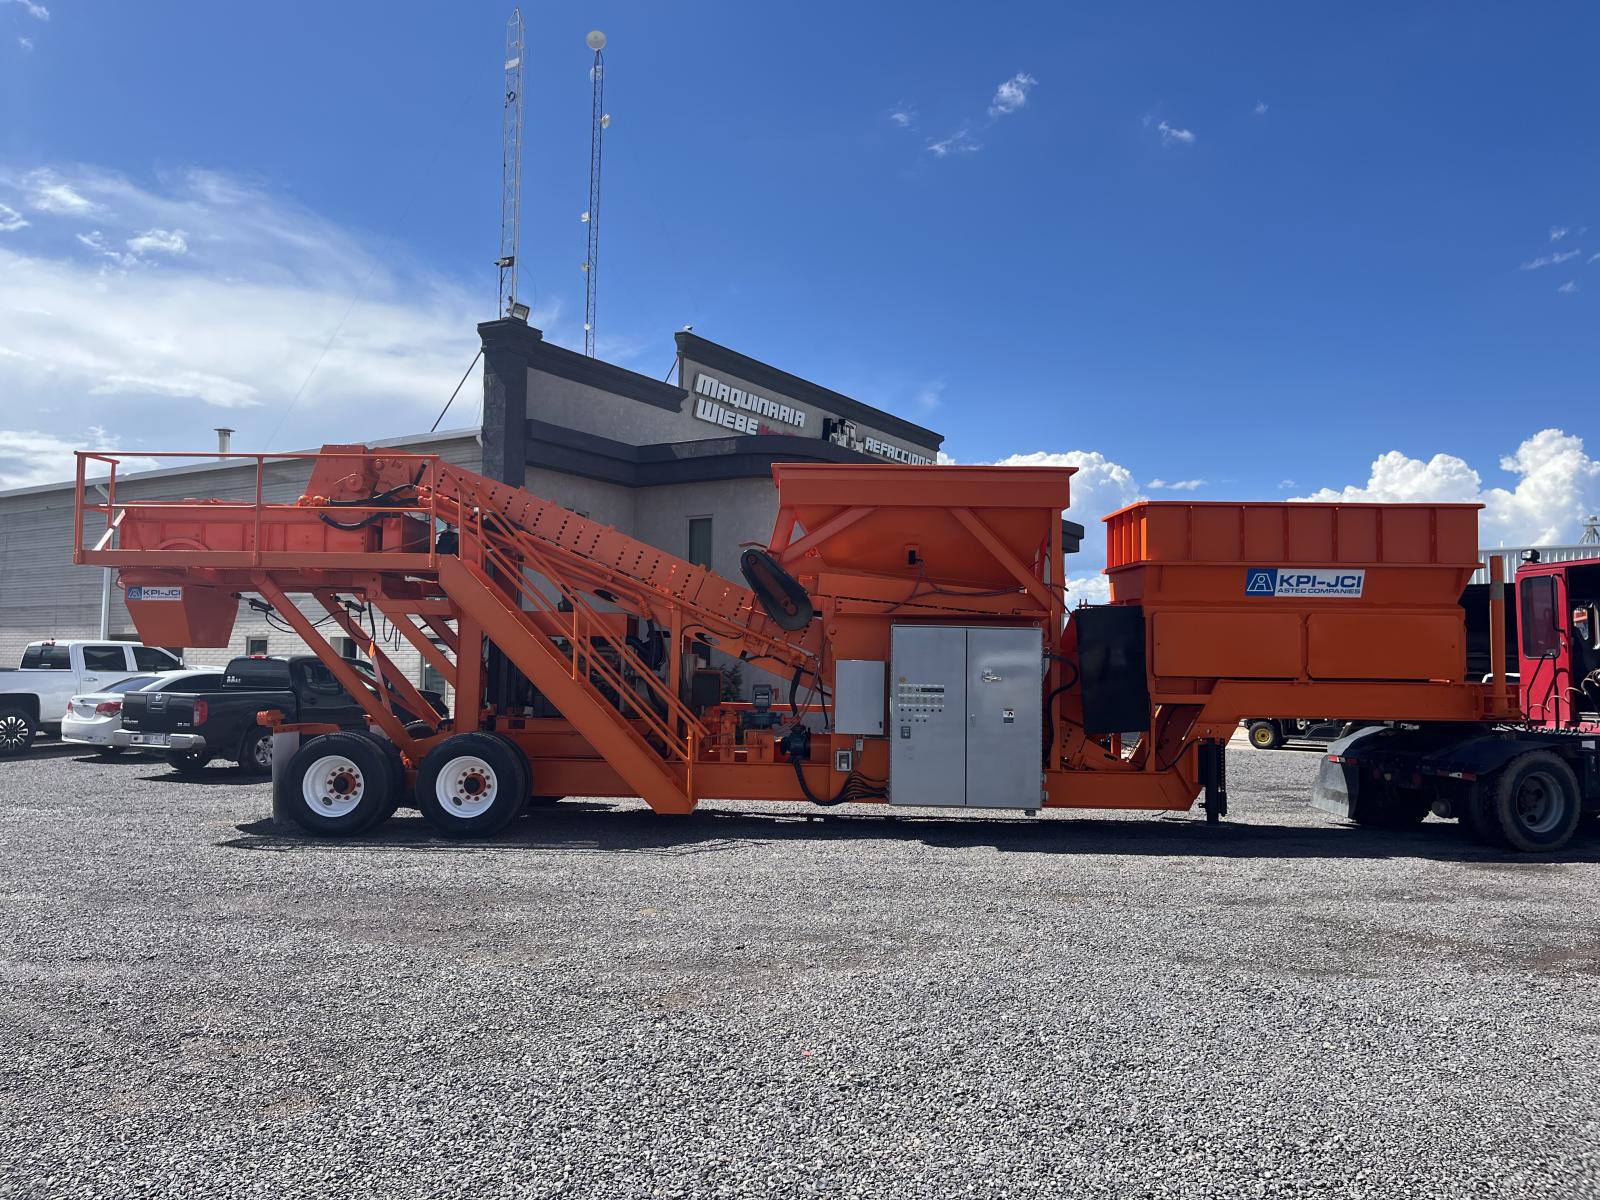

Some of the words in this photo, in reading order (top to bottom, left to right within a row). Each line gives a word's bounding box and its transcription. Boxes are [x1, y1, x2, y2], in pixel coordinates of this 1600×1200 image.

[696, 373, 806, 428] MAQUINARIA
[696, 398, 759, 436] WIEBE
[1279, 575, 1362, 588] KPI-JCI
[1307, 587, 1361, 595] COMPANIES
